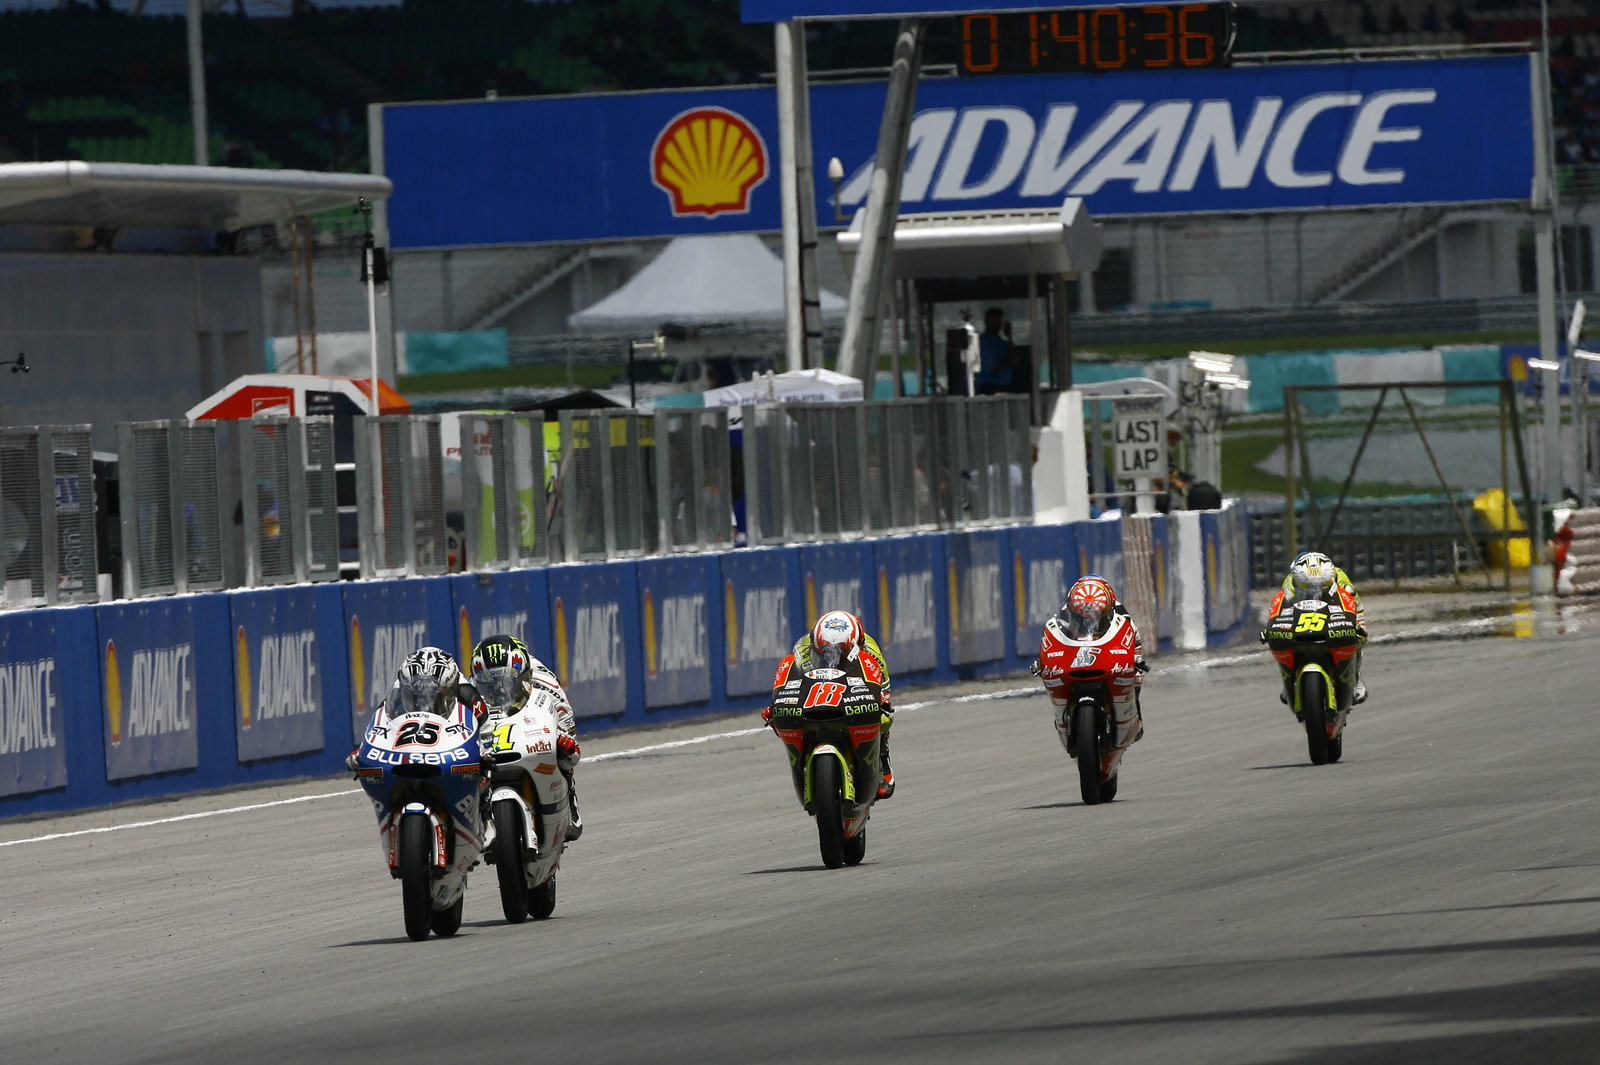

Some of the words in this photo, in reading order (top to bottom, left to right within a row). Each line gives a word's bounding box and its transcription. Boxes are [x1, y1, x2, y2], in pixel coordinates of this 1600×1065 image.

[962, 5, 1215, 72] 01:40:36
[840, 88, 1437, 204] ADVANCE
[1115, 420, 1160, 443] LAST
[1122, 449, 1159, 471] LAP
[1294, 612, 1328, 633] 55
[1328, 628, 1357, 640] Bankia
[256, 630, 316, 721] ADVANCE
[128, 643, 192, 738] ADVANCE
[803, 682, 847, 709] 18
[843, 694, 876, 703] MAPFRE
[0, 657, 56, 755] DVANCE
[773, 706, 803, 717] Bankia
[844, 702, 880, 716] Bankia
[371, 726, 391, 739] STX
[392, 720, 442, 750] 25
[445, 722, 471, 736] STX
